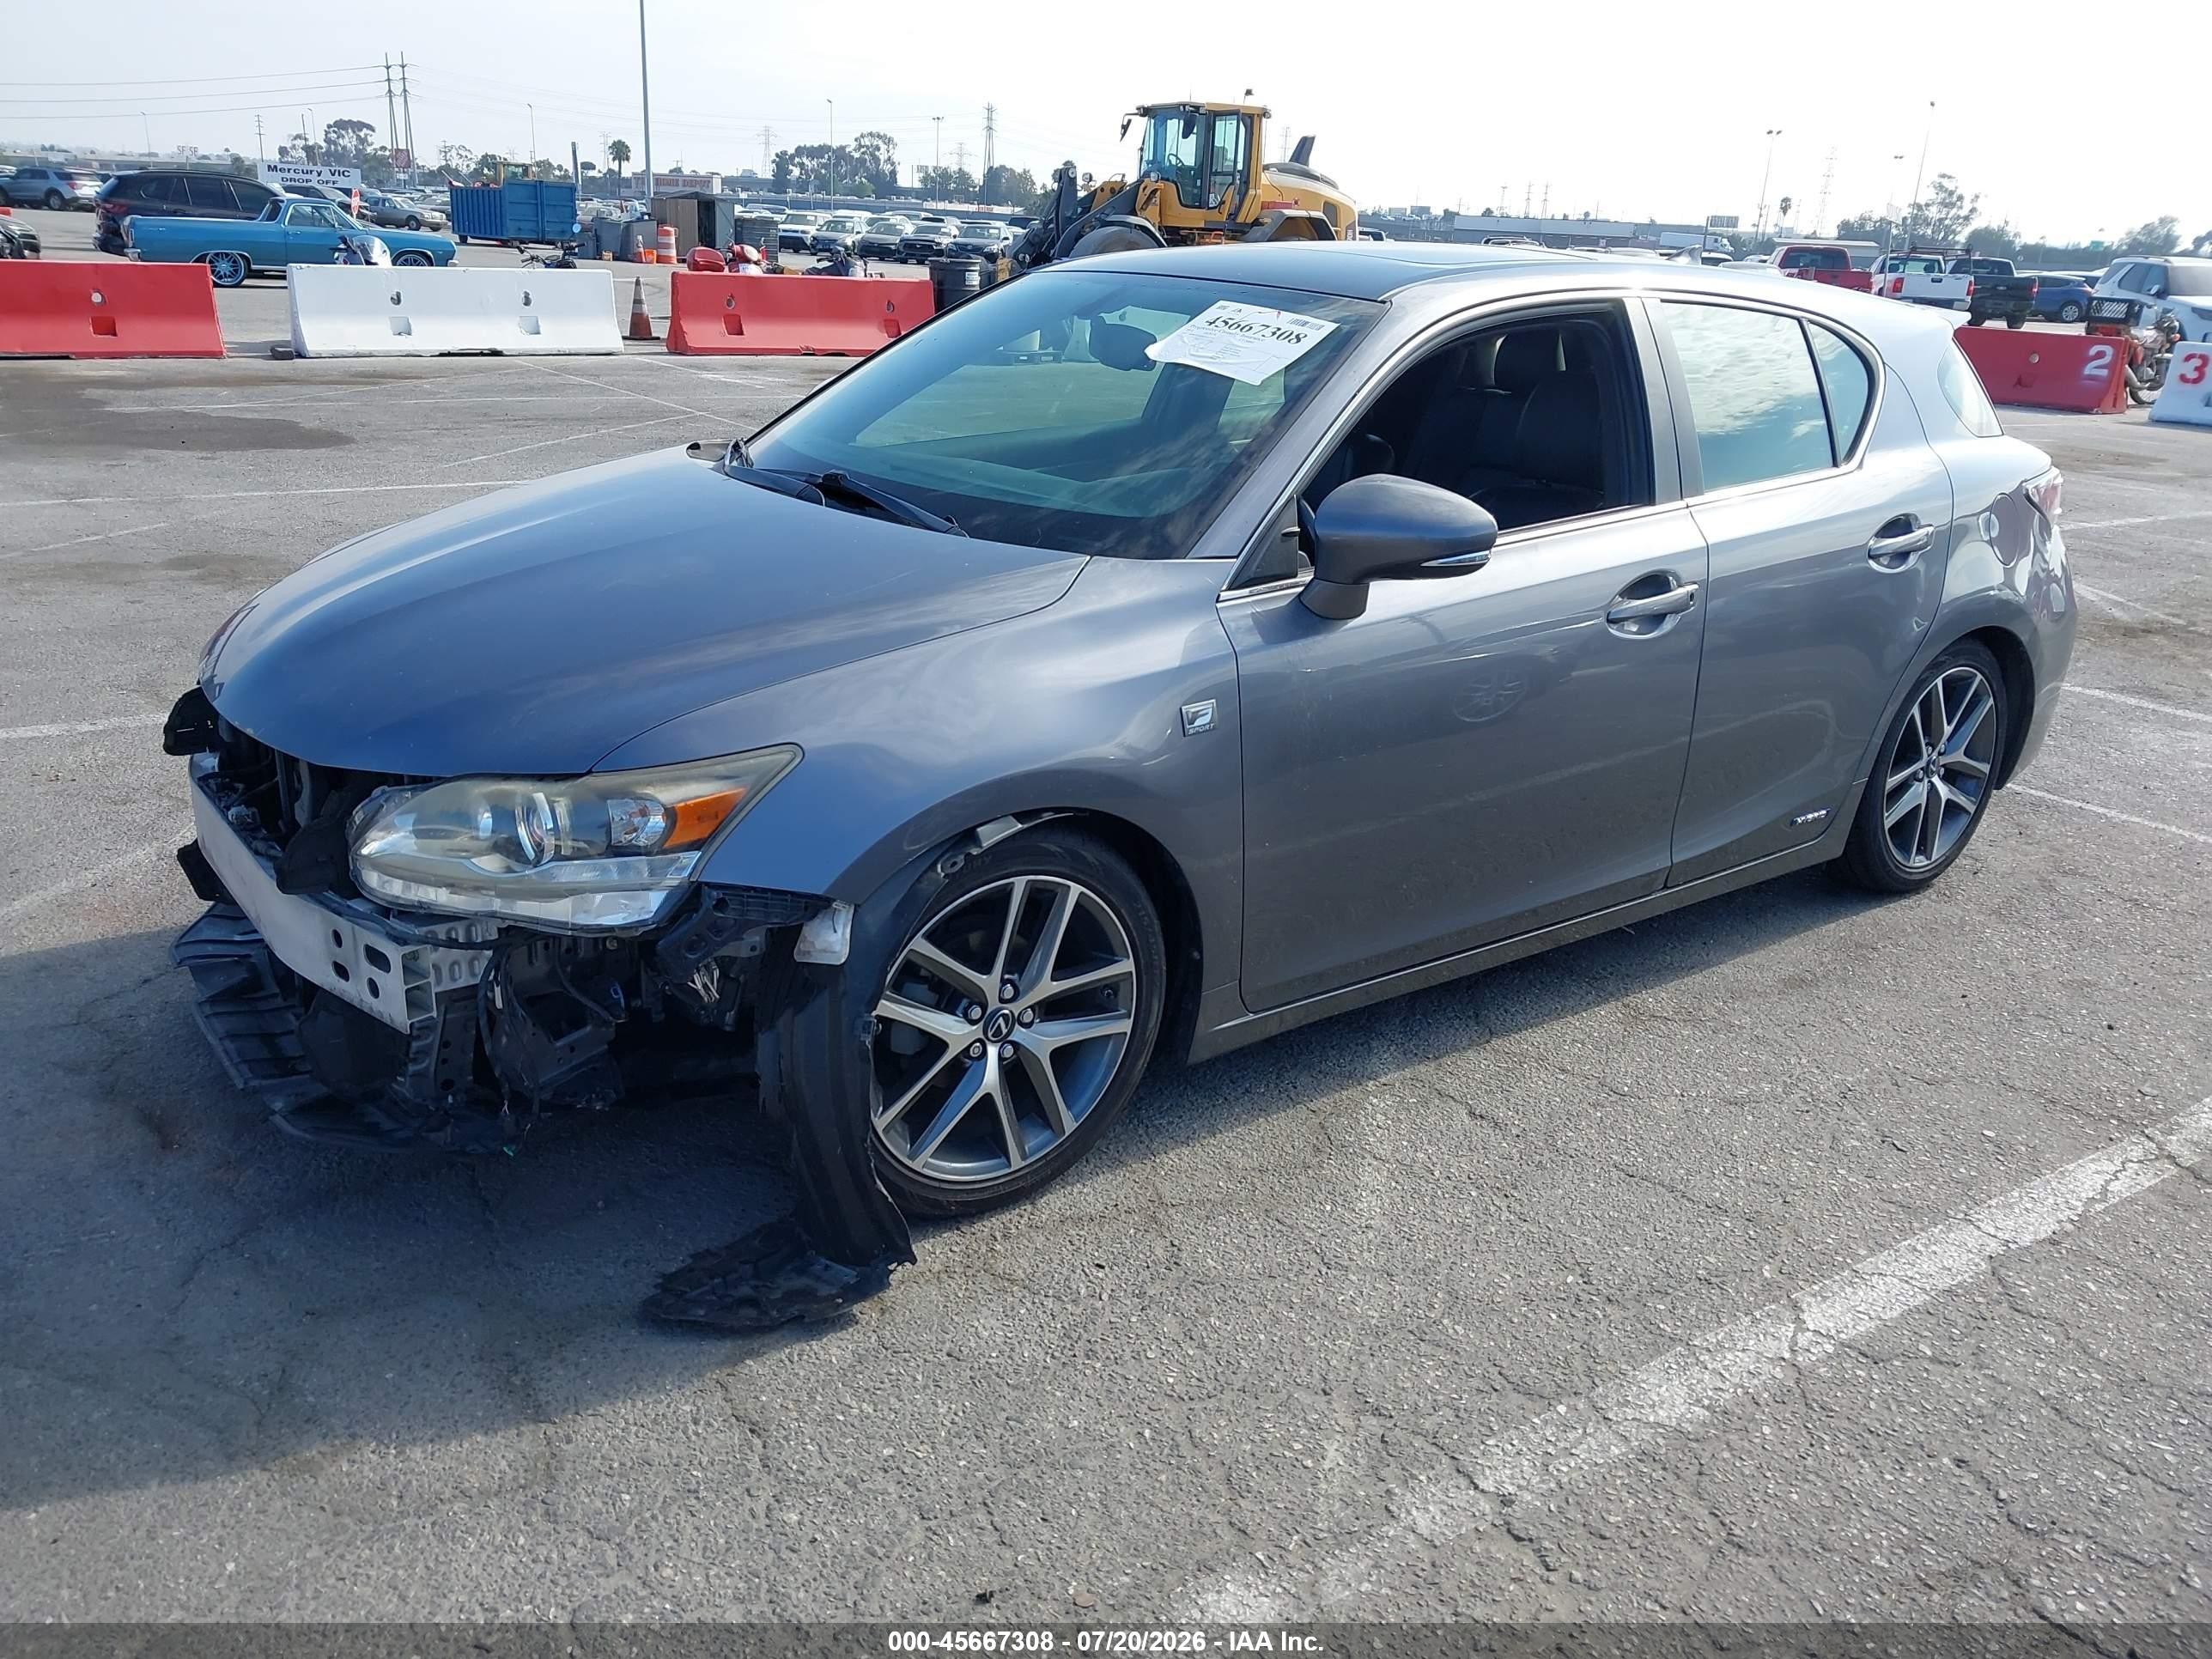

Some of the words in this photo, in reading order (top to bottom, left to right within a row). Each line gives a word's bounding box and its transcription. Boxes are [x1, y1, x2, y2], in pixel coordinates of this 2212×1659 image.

[267, 164, 323, 177] Mercury
[328, 168, 351, 178] VIC
[1206, 315, 1308, 344] 45667308
[2084, 344, 2114, 376] 2
[2179, 353, 2209, 384] 3
[1188, 723, 1214, 735] SPORT
